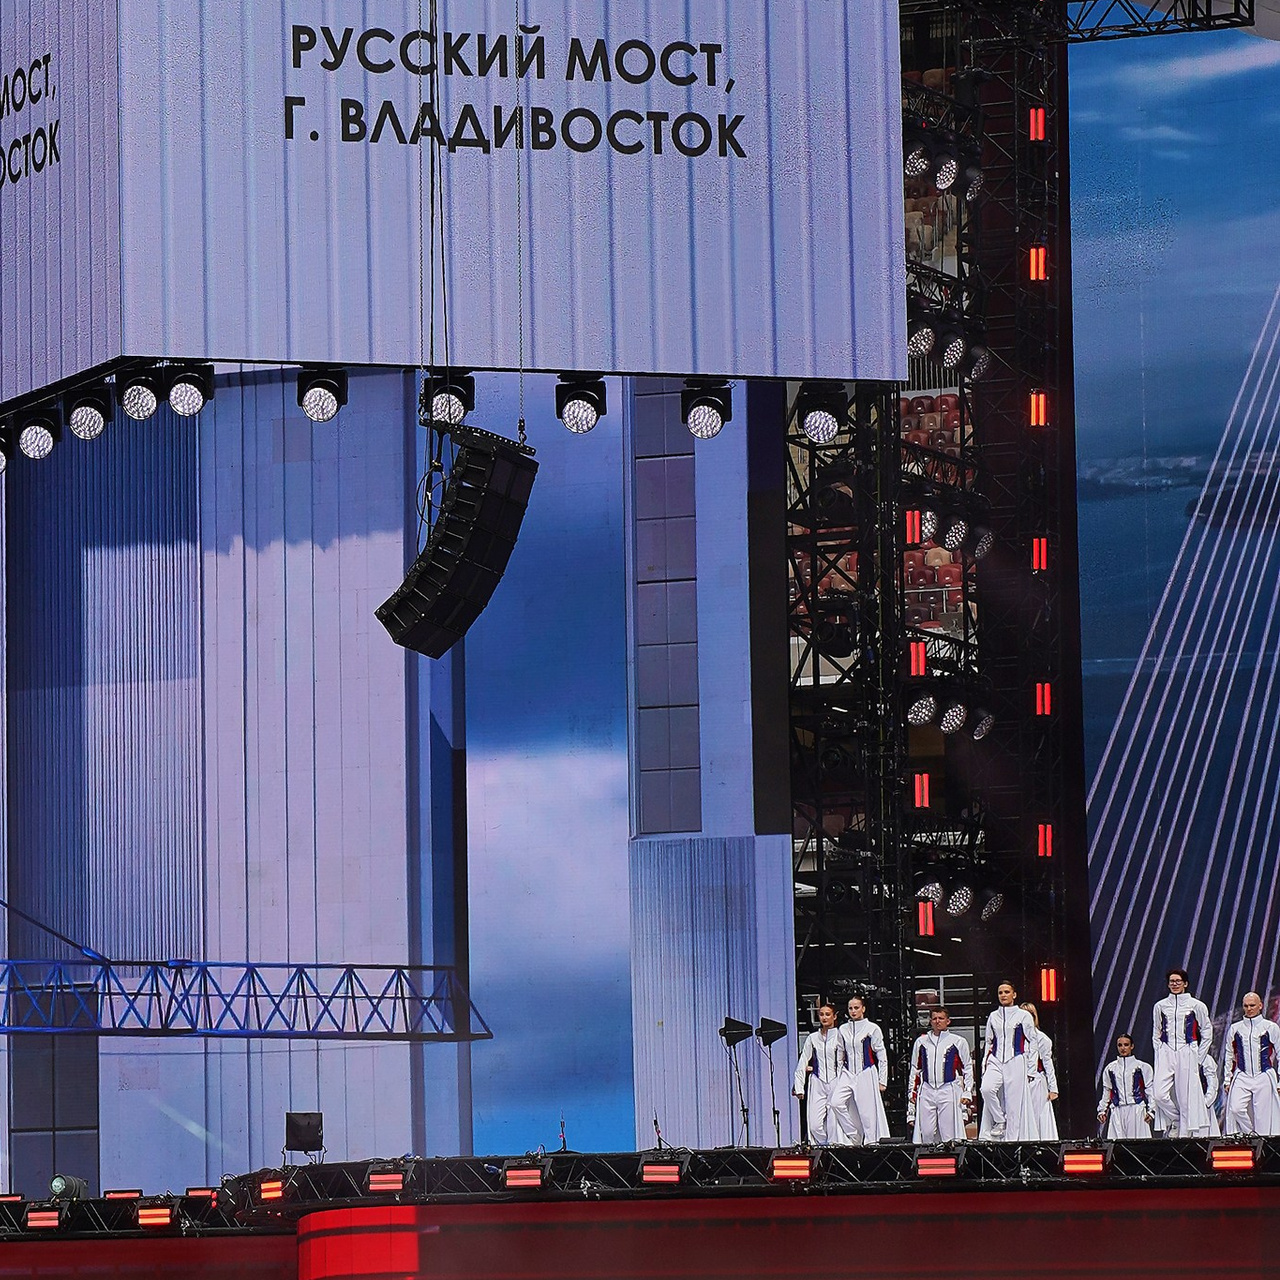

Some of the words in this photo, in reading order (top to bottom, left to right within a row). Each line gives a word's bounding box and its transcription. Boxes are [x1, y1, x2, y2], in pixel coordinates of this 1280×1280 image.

[291, 24, 546, 80] РУССКИЙ
[565, 37, 736, 95] МОСТ,
[284, 95, 319, 142] Г.
[340, 98, 748, 159] ВЛАДИВОСТОК
